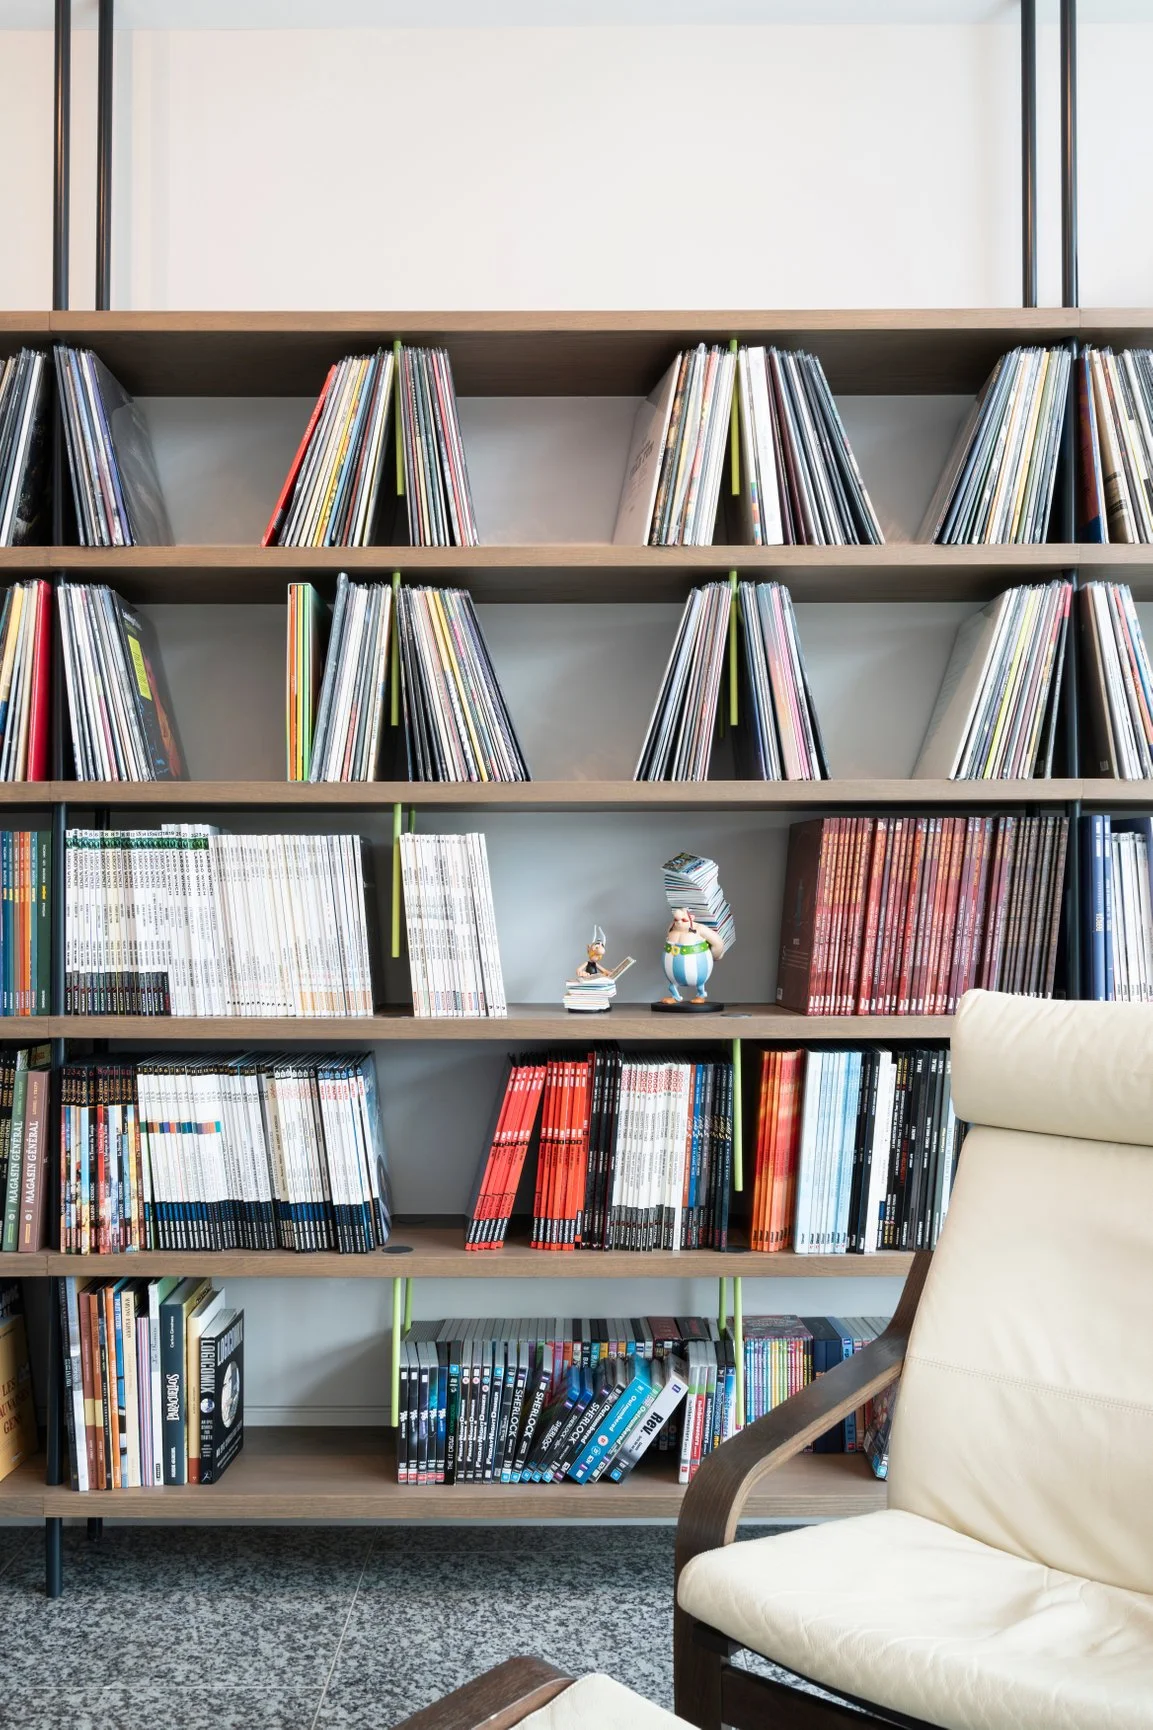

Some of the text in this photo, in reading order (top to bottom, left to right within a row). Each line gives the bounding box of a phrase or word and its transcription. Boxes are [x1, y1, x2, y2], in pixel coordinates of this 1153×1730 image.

[8, 1121, 23, 1204] MAGASIN GÉNÉRAL
[25, 1121, 38, 1203] MAGASIN GÉNÉRAL
[201, 1340, 215, 1393] LOGICOMIX
[166, 1374, 179, 1420] PARACUELLOS
[509, 1390, 524, 1437] SHERLOCK
[524, 1392, 544, 1438] SHERLOCK
[609, 1396, 637, 1432] Outnumbered
[541, 1420, 562, 1451] SHERLOCK
[560, 1415, 577, 1438] SHERLOCK
[569, 1402, 600, 1444] SHERLOCK
[580, 1402, 610, 1444] Outnumbered
[616, 1406, 646, 1444] Outnumbered
[640, 1412, 664, 1435] Rev.
